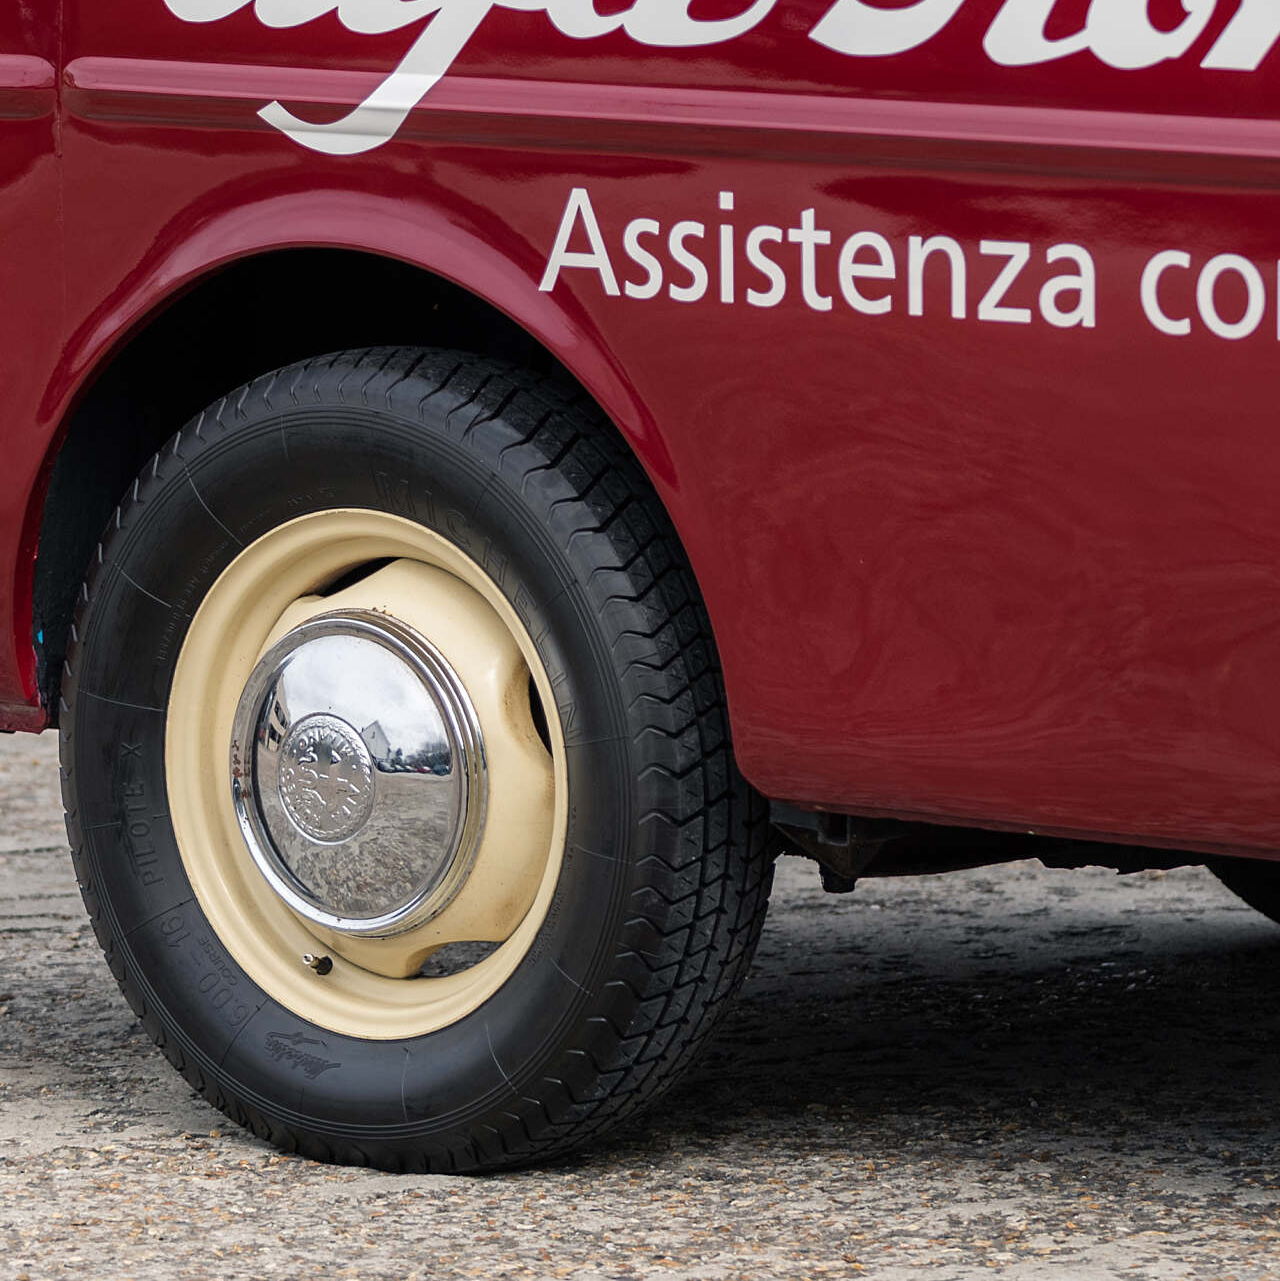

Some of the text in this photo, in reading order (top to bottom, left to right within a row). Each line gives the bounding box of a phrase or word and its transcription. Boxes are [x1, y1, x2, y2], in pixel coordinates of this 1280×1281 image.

[537, 187, 1096, 328] Assistenza
[371, 468, 582, 740] MICHELIN
[120, 741, 164, 888] PILOTE X
[198, 935, 239, 987] COURSE
